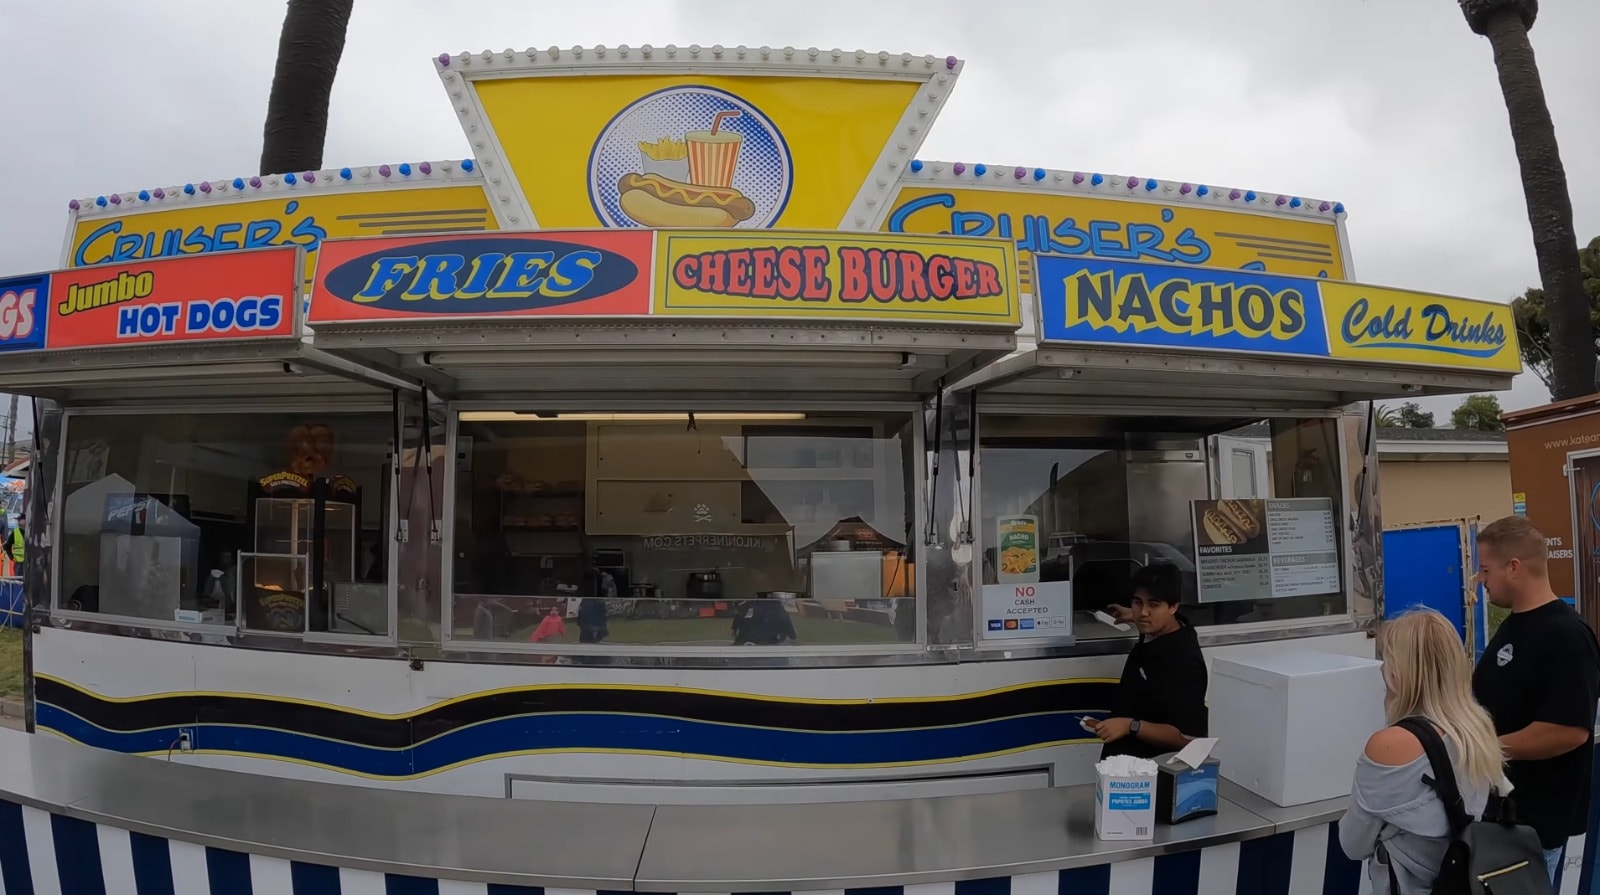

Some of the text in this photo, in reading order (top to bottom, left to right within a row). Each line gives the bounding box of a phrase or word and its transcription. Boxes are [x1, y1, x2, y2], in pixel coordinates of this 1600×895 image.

[59, 270, 154, 316] Jumbo
[352, 250, 602, 303] FRIES
[673, 245, 1002, 302] CHEESE BURGER
[117, 295, 284, 338] HOT DOGS
[1062, 267, 1306, 340] NACHOS
[1341, 298, 1507, 346] Cold Drinks
[1199, 546, 1232, 554] FAVORITES
[1274, 556, 1305, 564] BEVERAGES
[1006, 606, 1049, 614] ACCEPTED
[1015, 586, 1035, 597] NO
[1109, 781, 1150, 789] MONOGRAM
